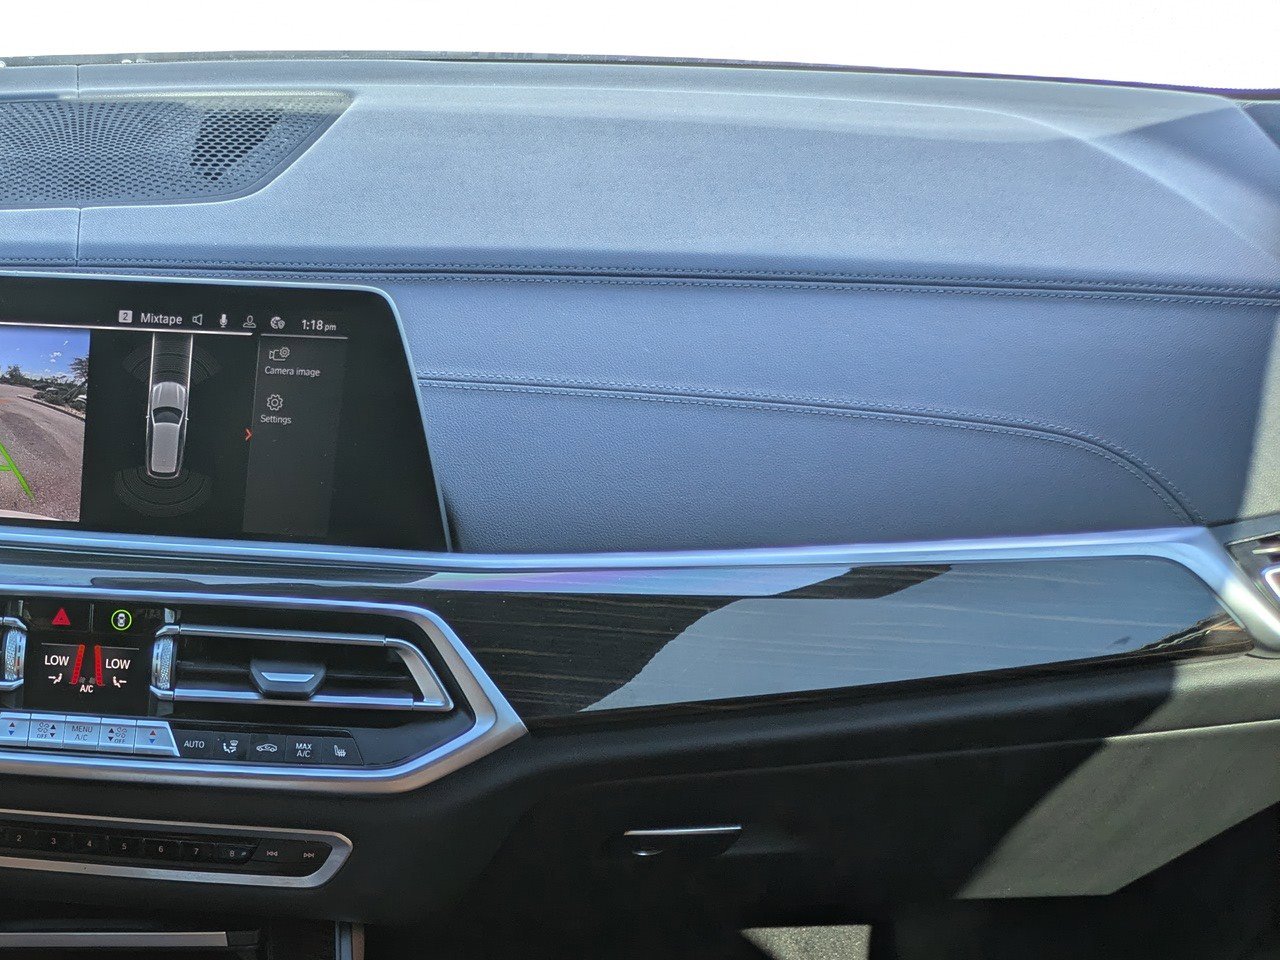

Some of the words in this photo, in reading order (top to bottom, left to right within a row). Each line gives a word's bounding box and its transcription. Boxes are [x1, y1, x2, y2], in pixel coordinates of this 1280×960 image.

[140, 313, 183, 326] Mixtape
[301, 319, 323, 331] 1:18
[324, 323, 337, 332] pm
[265, 366, 294, 376] Camera
[296, 367, 321, 377] image
[260, 414, 292, 425] Settings
[44, 655, 69, 666] LOW
[105, 659, 131, 670] LOW
[80, 684, 94, 693] A/C
[71, 725, 93, 733] MENU
[183, 740, 205, 749] AUTO
[295, 742, 312, 750] MAX
[296, 750, 311, 758] A/C
